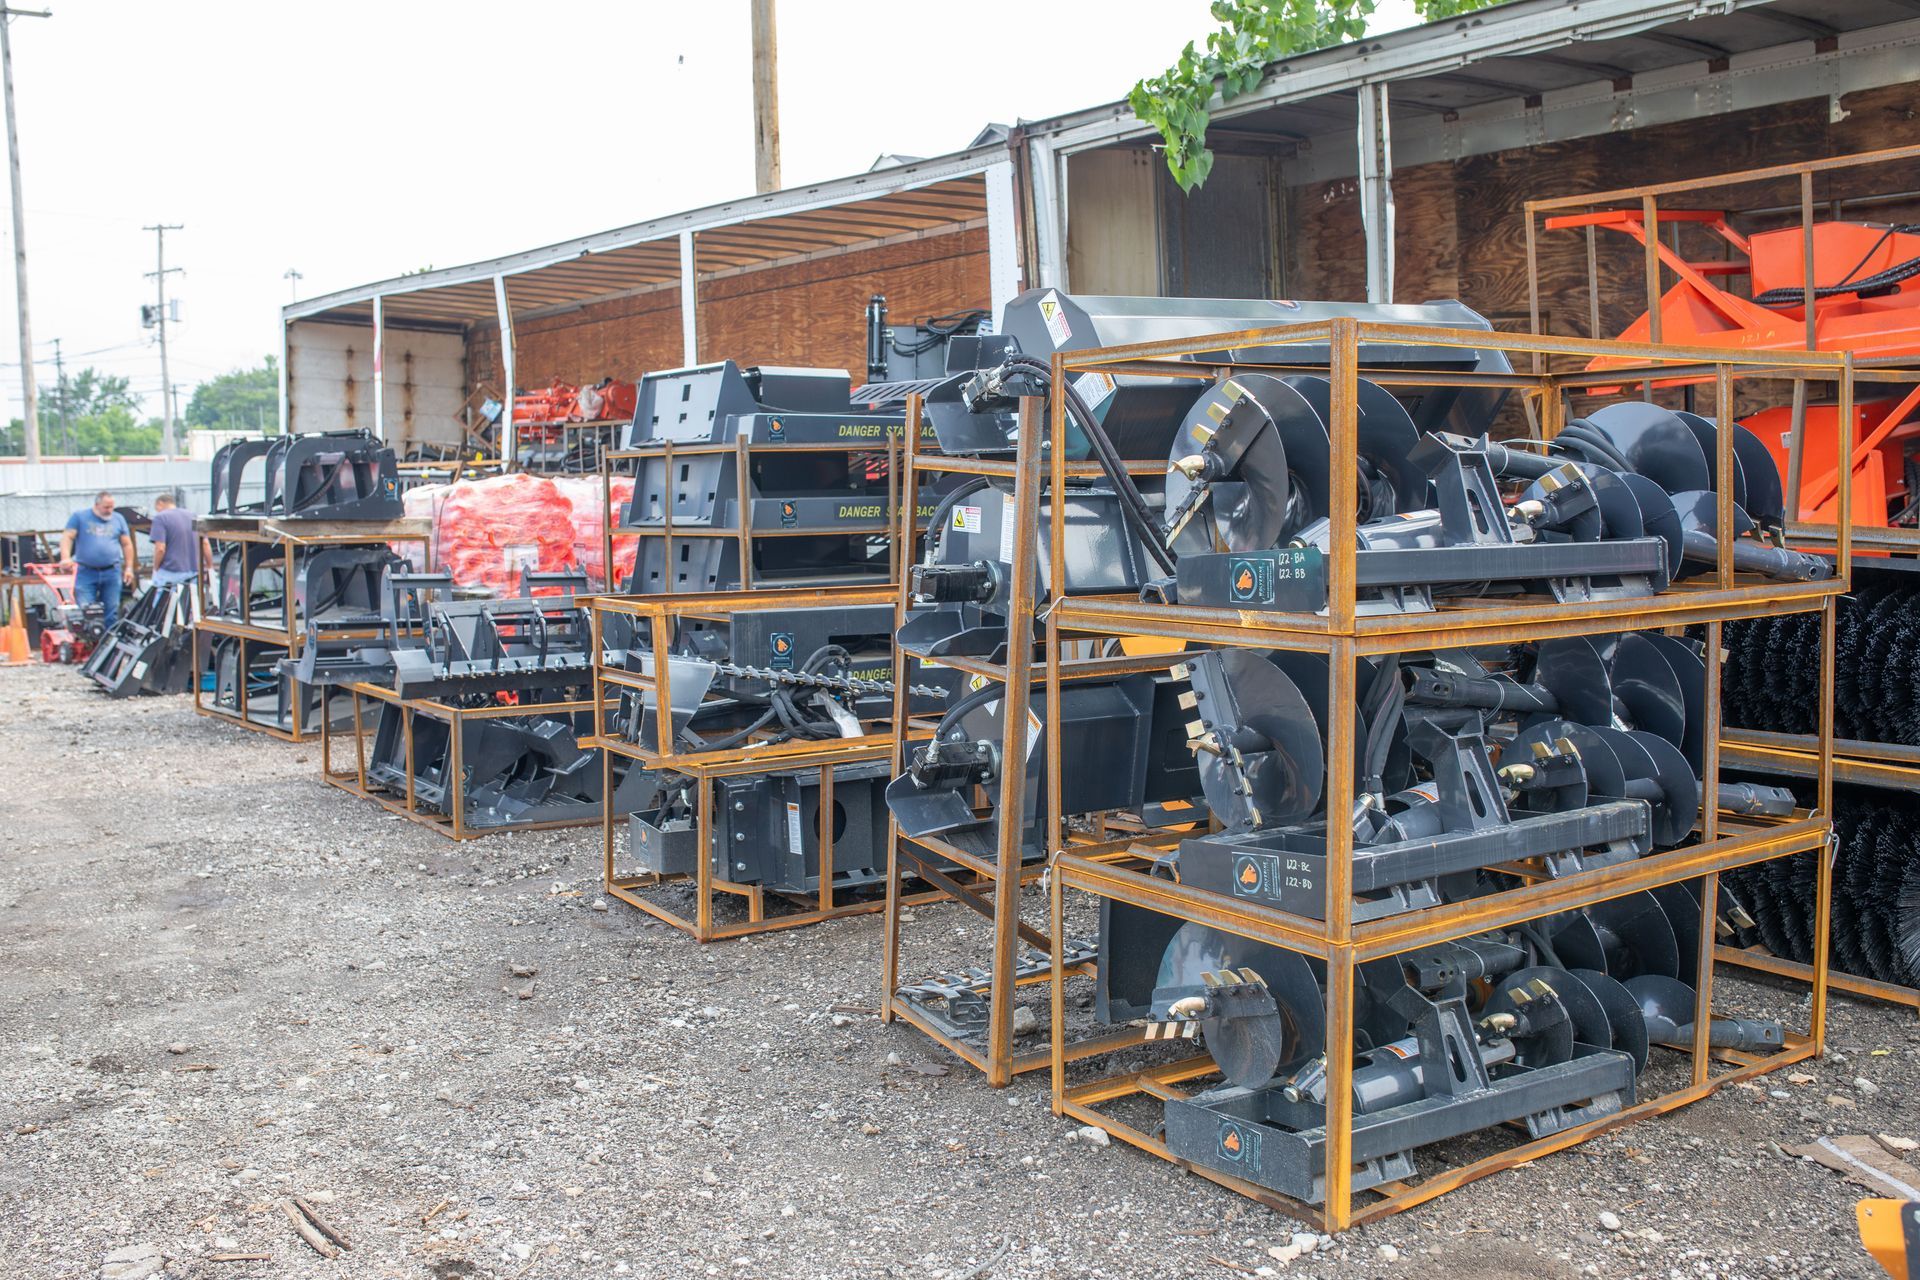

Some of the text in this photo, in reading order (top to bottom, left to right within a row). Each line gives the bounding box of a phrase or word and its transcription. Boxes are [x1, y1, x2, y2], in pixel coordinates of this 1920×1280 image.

[838, 425, 881, 437] DANGER
[886, 425, 906, 437] STA
[839, 506, 881, 518] DANGER
[853, 668, 893, 681] DANGER
